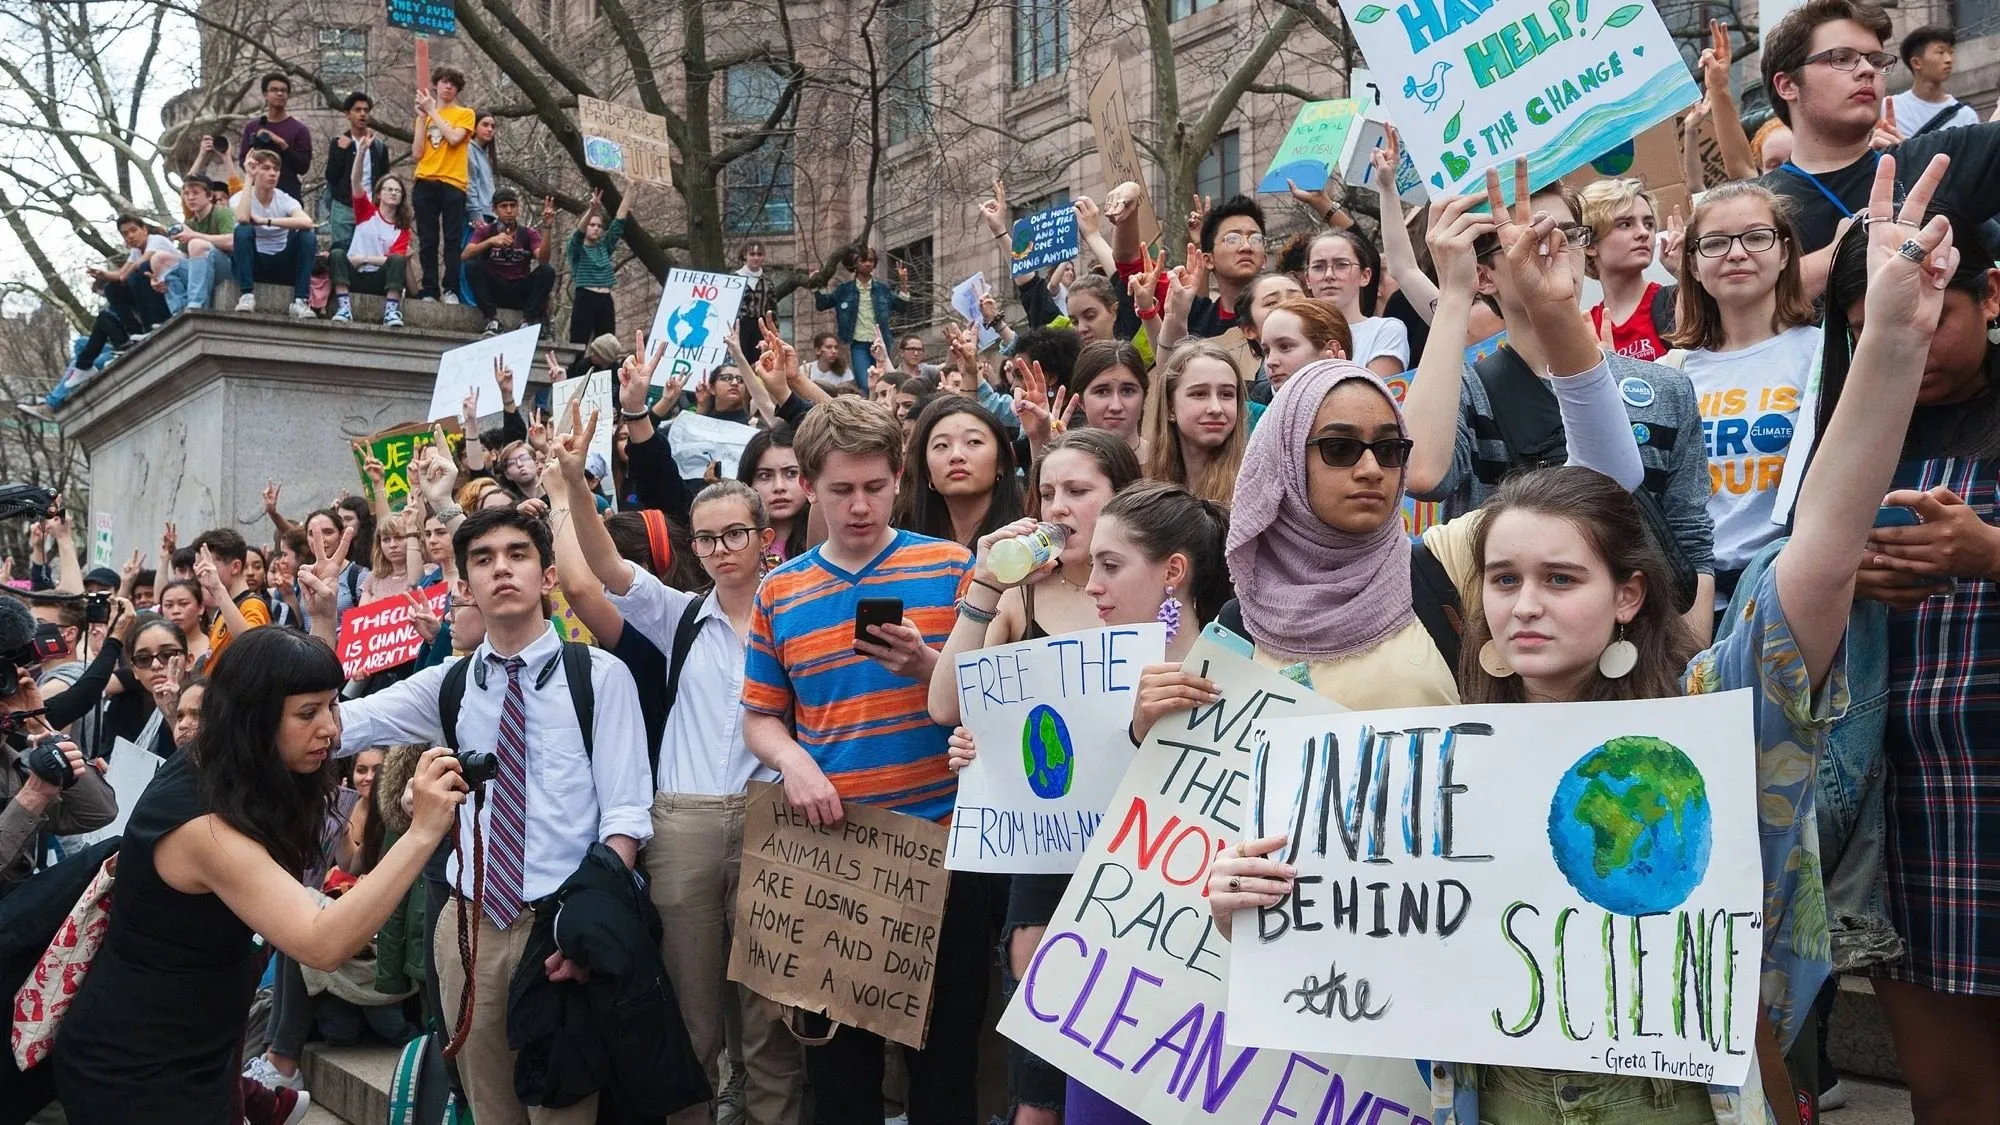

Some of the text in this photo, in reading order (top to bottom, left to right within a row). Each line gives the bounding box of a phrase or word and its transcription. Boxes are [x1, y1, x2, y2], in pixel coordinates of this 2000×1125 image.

[392, 11, 414, 25] OUR
[1464, 0, 1589, 89] HELP!
[584, 108, 625, 130] PRIDE
[587, 98, 650, 125] PUT YOUR
[1479, 111, 1518, 155] THE
[1525, 51, 1624, 125] CHANGE
[1030, 212, 1047, 225] OUR
[1033, 213, 1075, 232] IS ON FIRE
[1034, 225, 1070, 241] AND NO
[1012, 256, 1040, 274] DOING
[1034, 236, 1065, 251] ONE IS
[672, 271, 743, 290] THERE IS
[692, 285, 718, 301] NO
[1697, 385, 1799, 417] HIS IS
[1750, 426, 1792, 437] CLIMATE
[345, 624, 420, 658] IS CHANG
[363, 645, 407, 670] AREN'T
[958, 631, 1138, 715] FREE THE
[1187, 660, 1297, 753] WE
[1157, 738, 1250, 833] THE
[952, 806, 1029, 859] FROM
[1107, 796, 1226, 898] NO
[760, 832, 930, 903] ANIMALS THAT
[749, 901, 805, 944] HOME
[823, 930, 873, 962] AND
[752, 868, 936, 954] ARE LOSING THEIR
[1075, 863, 1222, 982] RACE
[1258, 876, 1473, 945] BEHIND
[748, 936, 921, 1018] HAVE A VOICE
[1283, 960, 1394, 1023] the
[1024, 930, 1260, 1114] CLEAN
[1605, 1047, 1647, 1074] Greta
[1651, 1050, 1714, 1083] Thunberg
